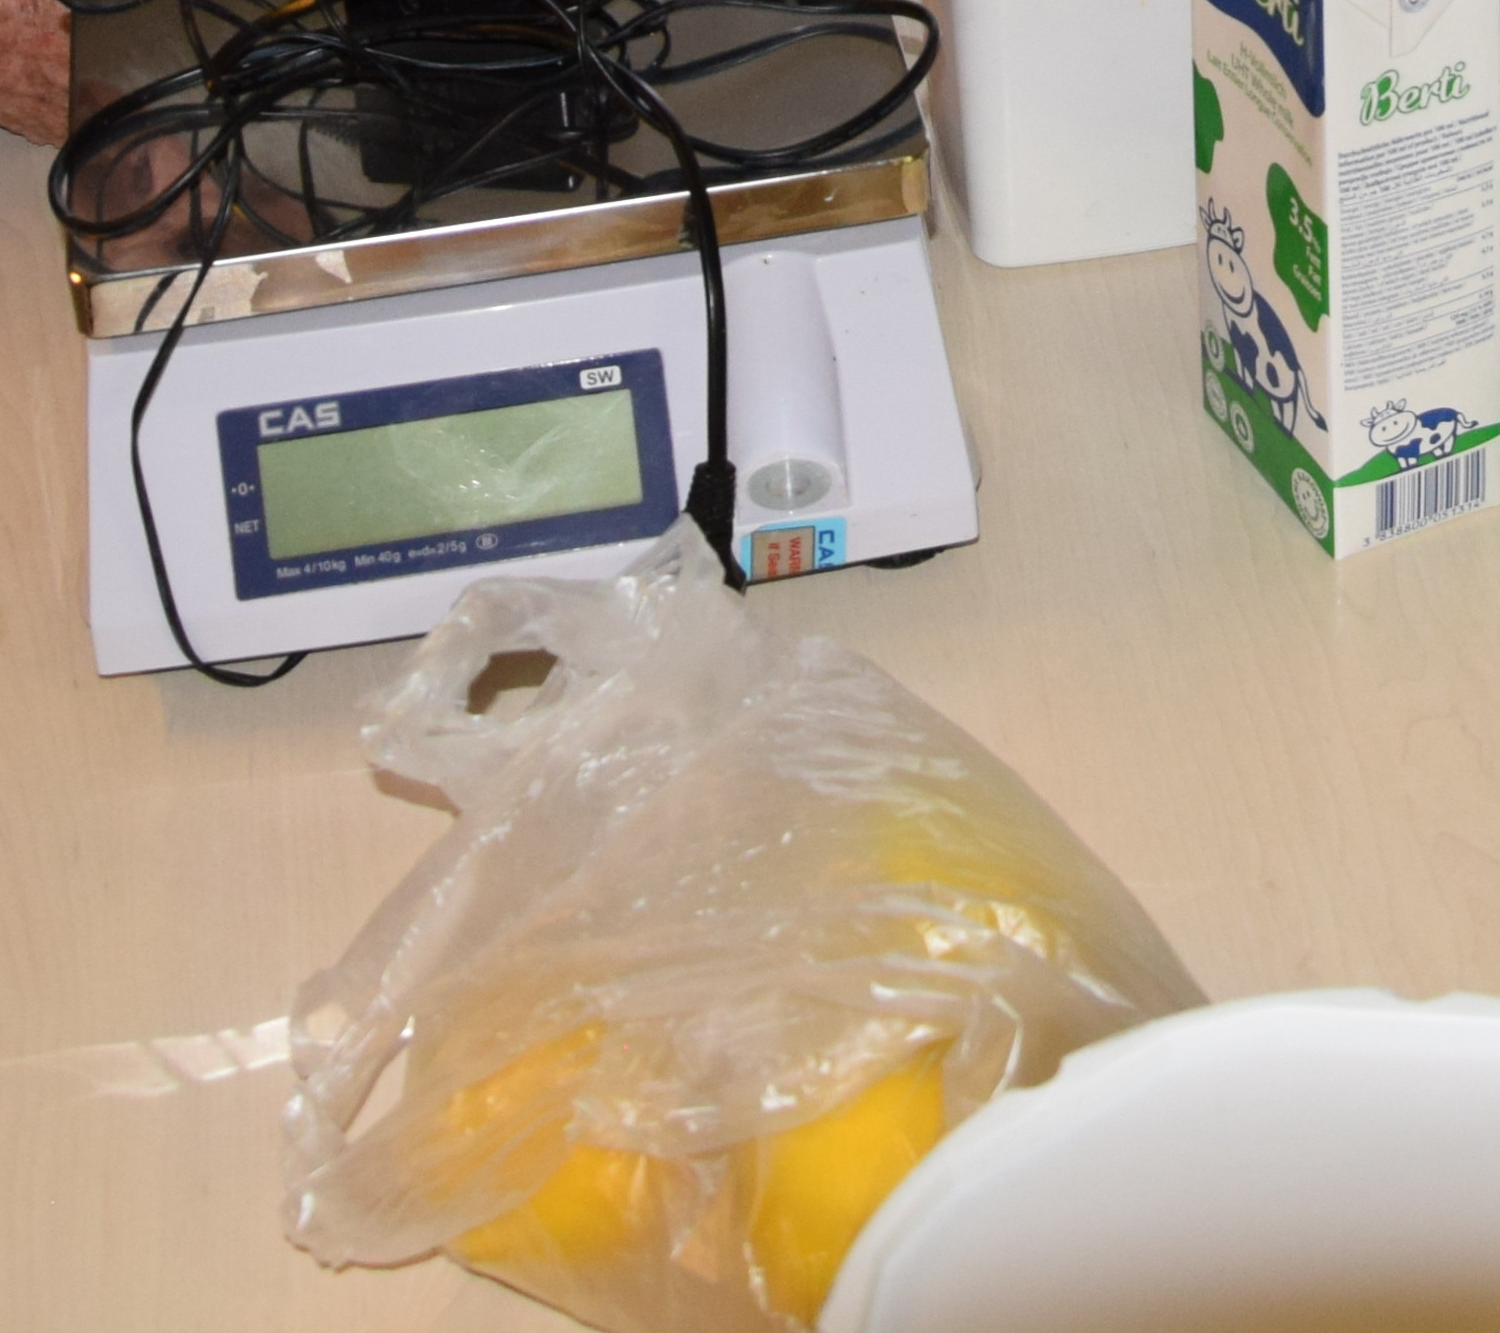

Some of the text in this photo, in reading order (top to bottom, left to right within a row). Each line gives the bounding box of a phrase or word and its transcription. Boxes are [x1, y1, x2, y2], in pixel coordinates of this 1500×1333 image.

[1359, 61, 1471, 126] Berti
[586, 368, 616, 386] SW
[258, 400, 342, 436] CAS
[234, 519, 261, 534] NET
[276, 566, 302, 579] Max
[354, 553, 376, 567] Min
[377, 549, 402, 564] 40g
